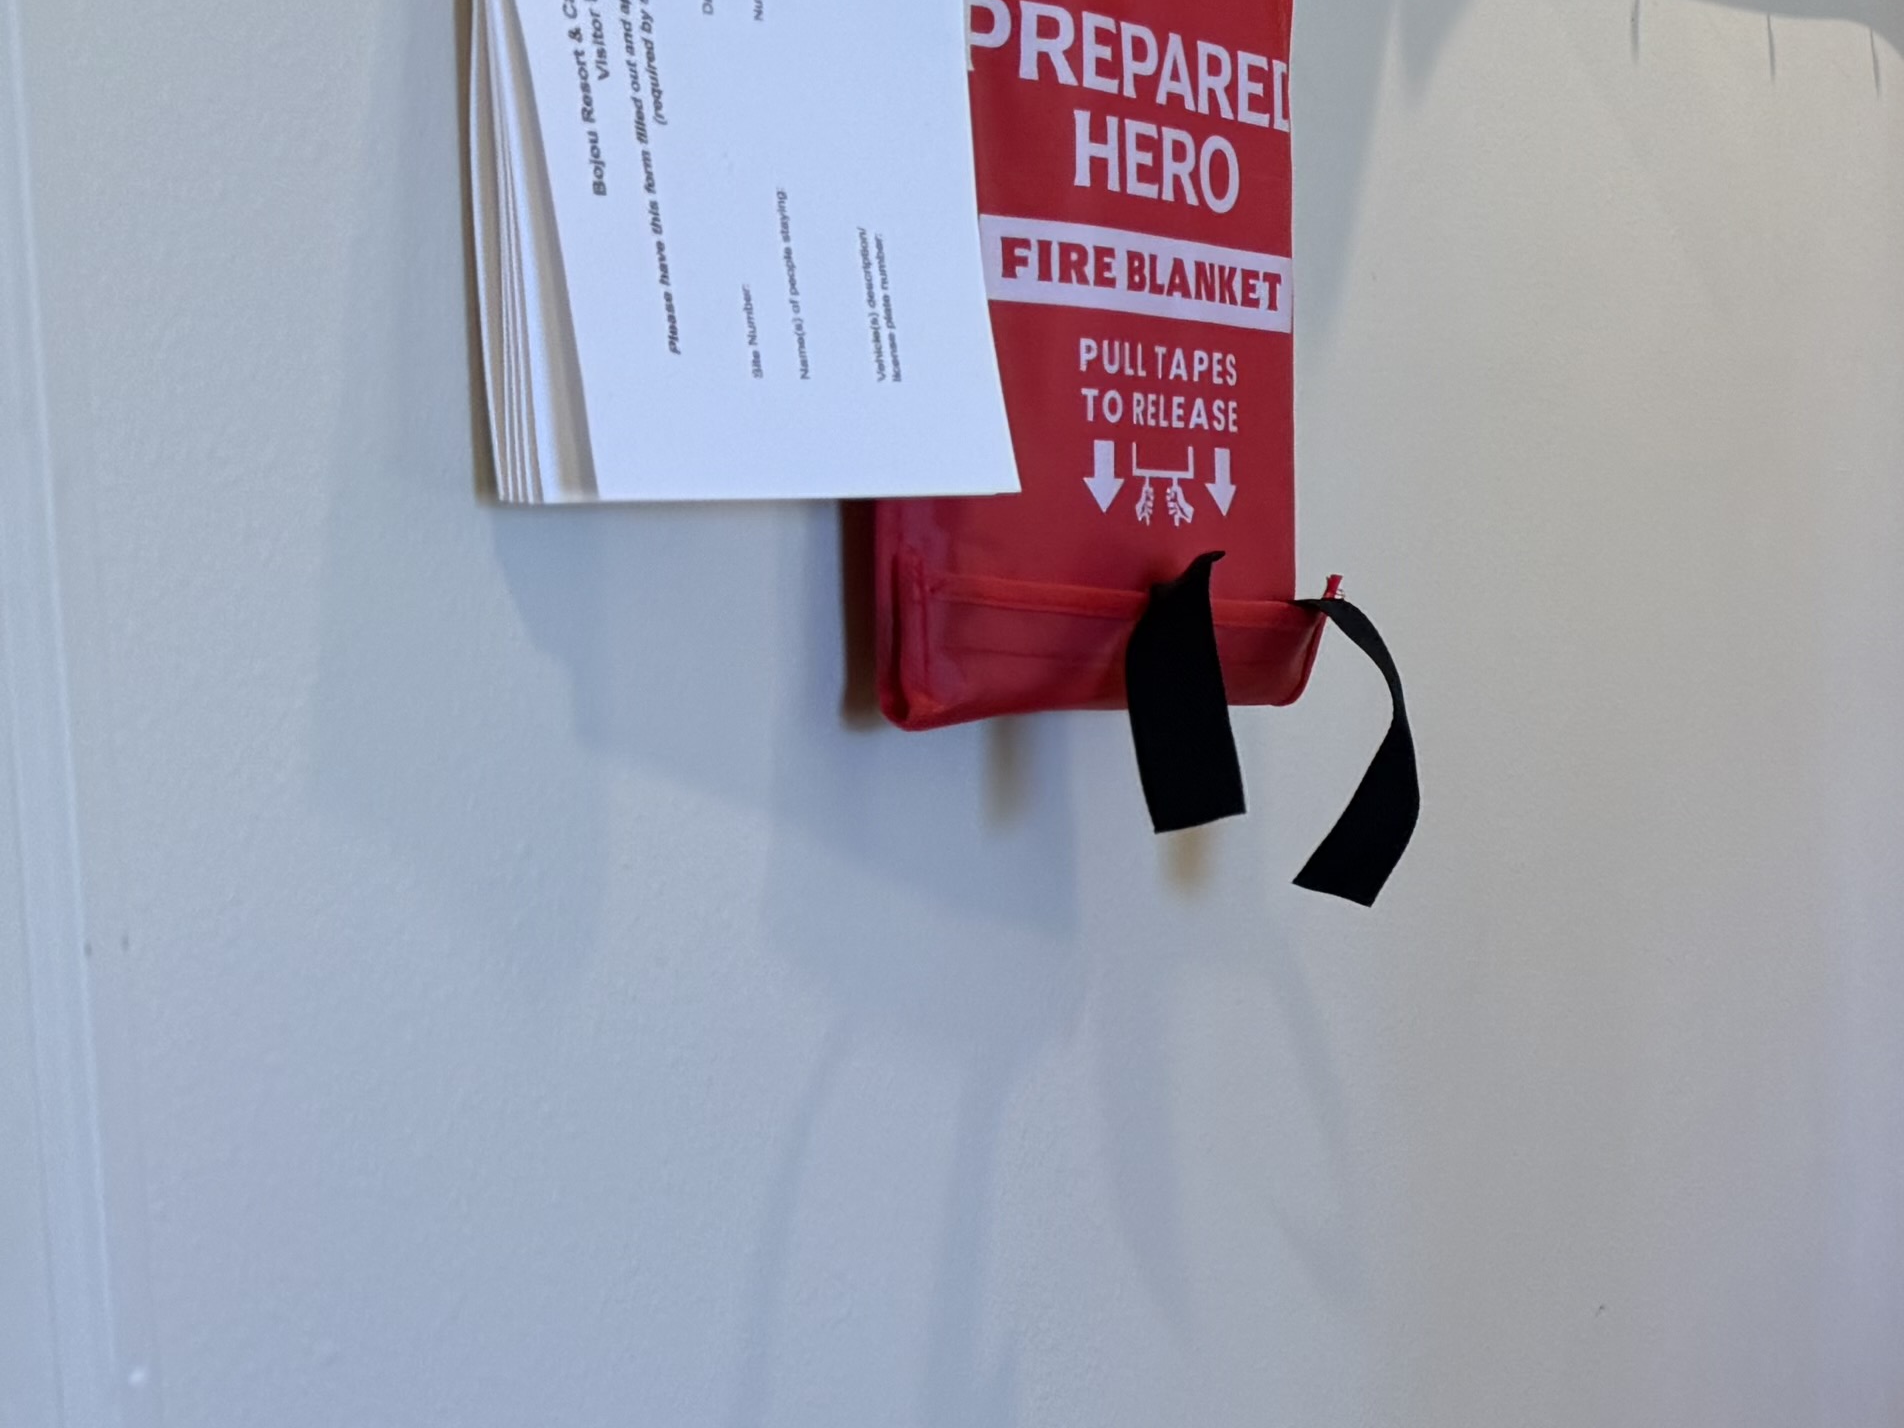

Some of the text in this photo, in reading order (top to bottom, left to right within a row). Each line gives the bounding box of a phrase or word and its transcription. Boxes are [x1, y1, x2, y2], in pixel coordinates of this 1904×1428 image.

[568, 30, 583, 43] &
[589, 8, 610, 80] Visitor
[622, 19, 635, 56] and
[637, 10, 653, 34] by
[576, 51, 595, 123] Resort
[626, 60, 640, 93] out
[641, 38, 668, 126] (required
[631, 97, 648, 144] filled
[587, 130, 606, 196] Bojou
[639, 149, 656, 194] form
[1073, 109, 1240, 213] HERO
[645, 201, 663, 235] this
[654, 240, 670, 286] have
[783, 247, 799, 296] people
[1000, 236, 1283, 311] FIRE BLANKET
[663, 292, 681, 355] Please
[790, 298, 800, 314] of
[882, 293, 897, 330] plate
[886, 333, 902, 382] license
[1079, 338, 1237, 386] PULL TAPES
[1081, 388, 1238, 432] TO RELEASE
